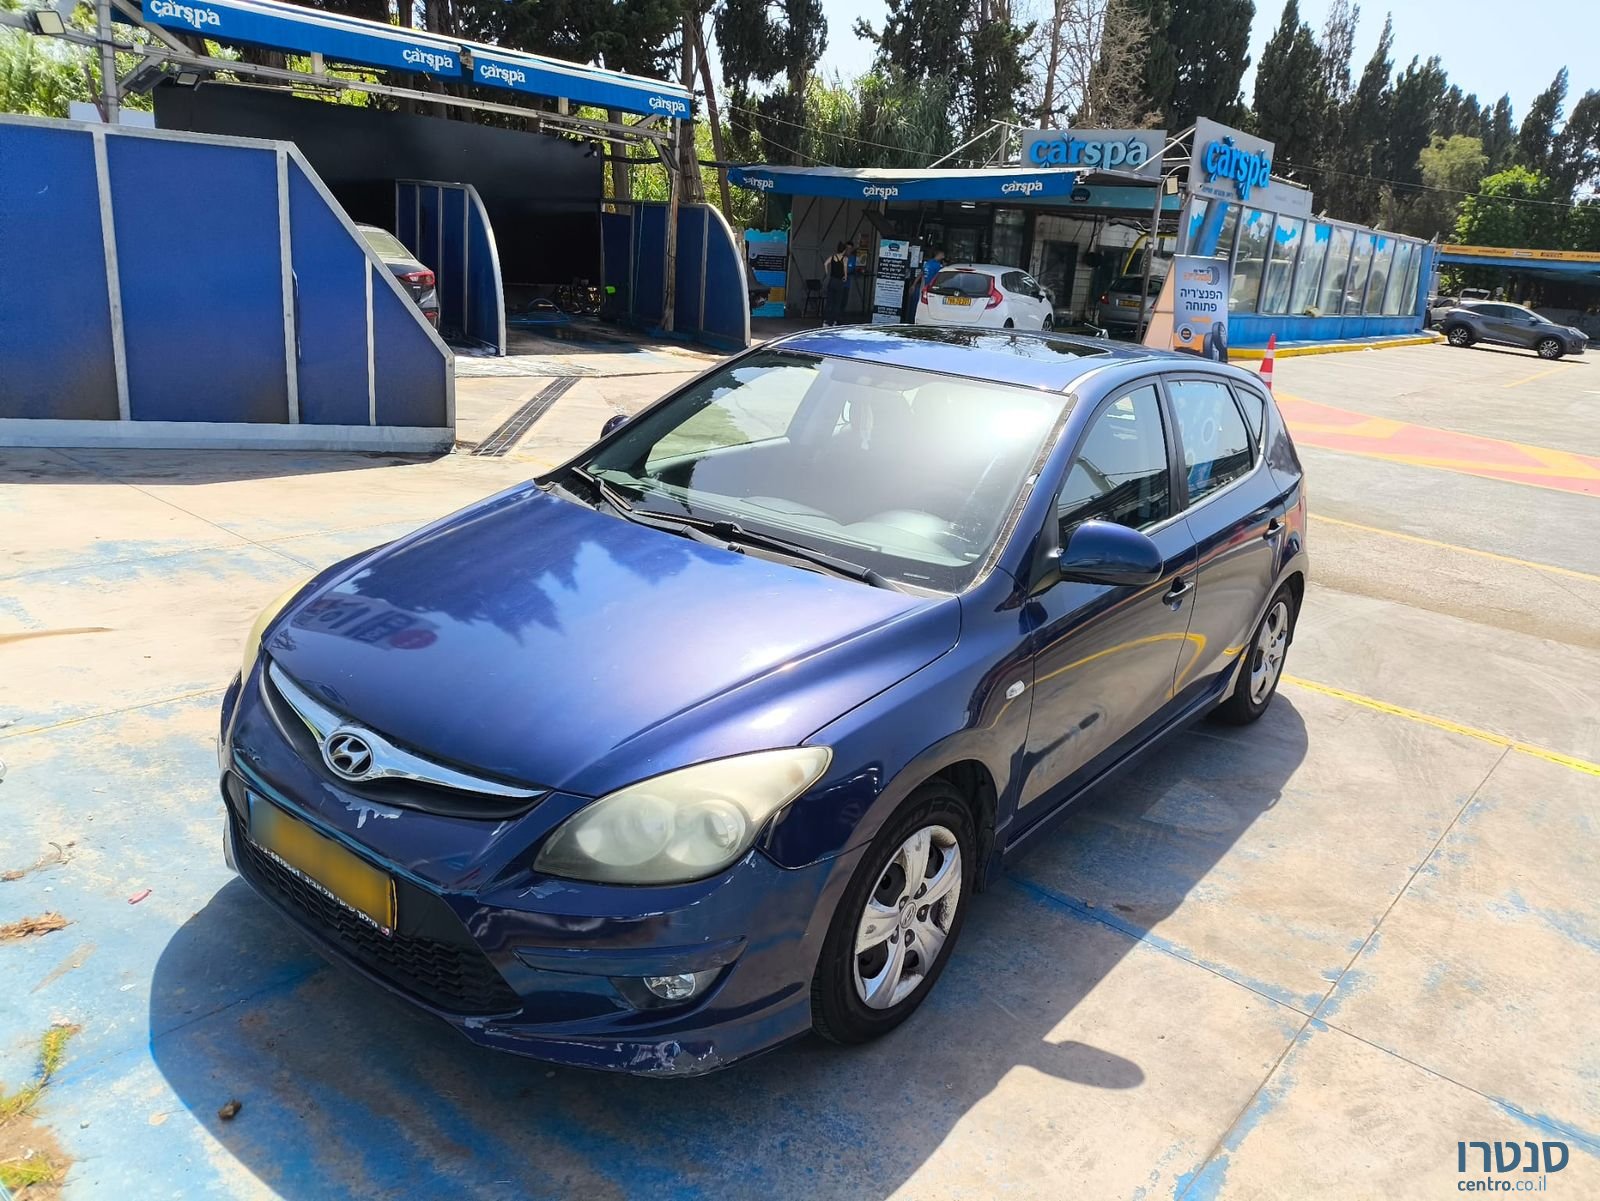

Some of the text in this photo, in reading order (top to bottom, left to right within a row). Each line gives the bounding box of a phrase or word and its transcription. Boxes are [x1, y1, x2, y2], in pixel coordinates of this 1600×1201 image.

[150, 0, 221, 28] carspa
[402, 47, 453, 72] carspa
[480, 64, 526, 86] carspa
[648, 96, 686, 116] carspa
[1030, 133, 1147, 170] carspa
[1201, 135, 1272, 201] carspa
[863, 184, 899, 199] carspa
[1001, 180, 1043, 196] carspa
[1180, 288, 1223, 300] הפנצ'ריה
[1185, 301, 1217, 312] פתוחה
